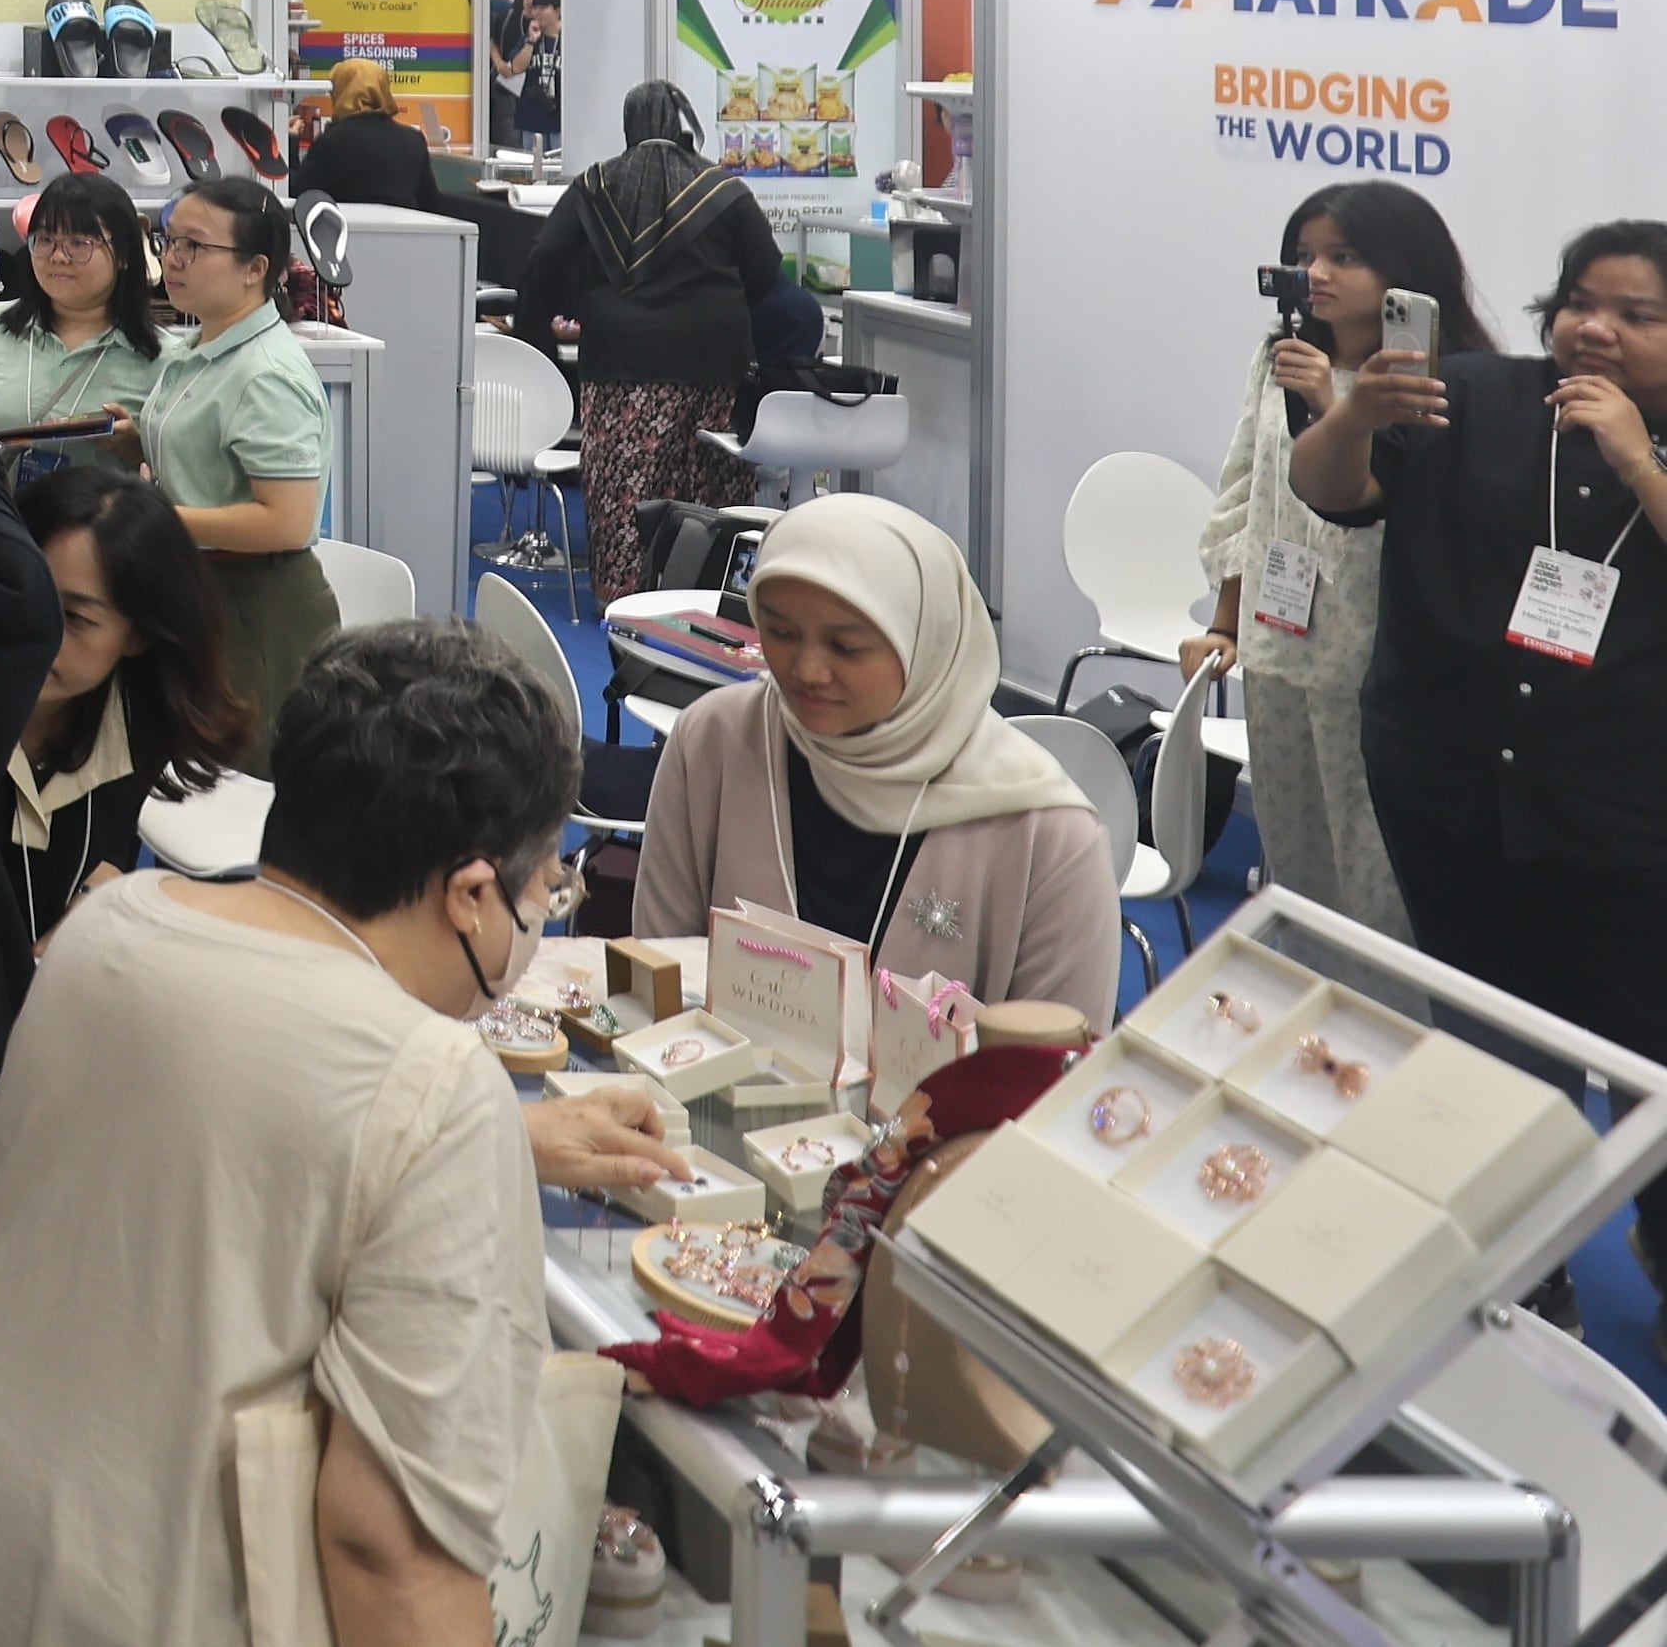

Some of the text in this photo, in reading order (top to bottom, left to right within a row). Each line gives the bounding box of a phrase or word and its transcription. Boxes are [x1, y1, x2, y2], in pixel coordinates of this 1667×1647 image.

[343, 33, 385, 45] SPICES
[343, 46, 418, 59] SEASONINGS
[1213, 62, 1451, 124] BRIDGING
[1215, 114, 1452, 176] THE WORLD
